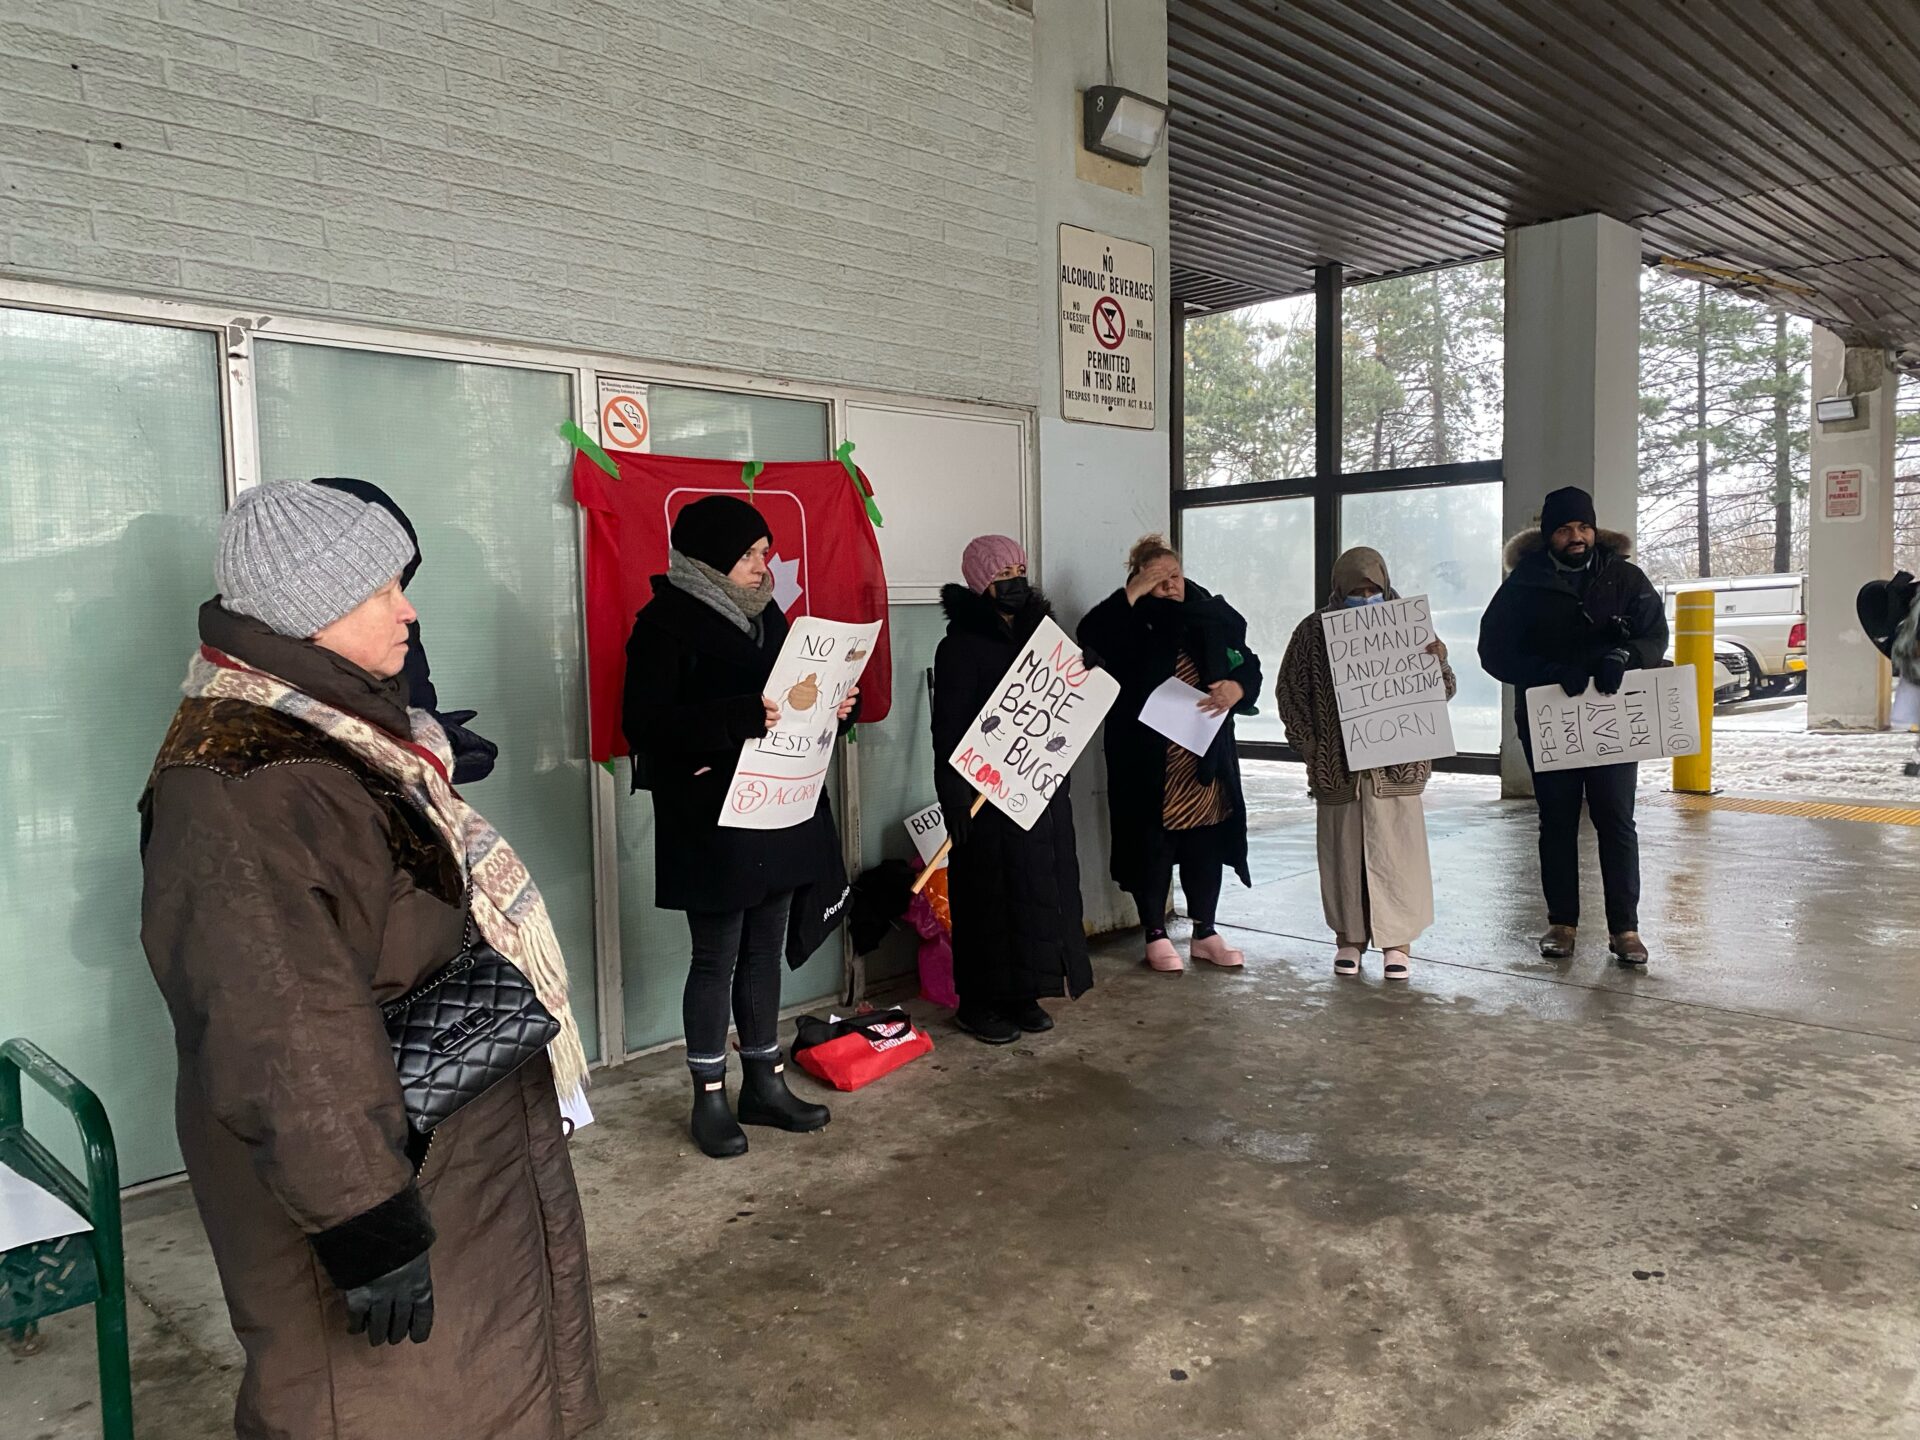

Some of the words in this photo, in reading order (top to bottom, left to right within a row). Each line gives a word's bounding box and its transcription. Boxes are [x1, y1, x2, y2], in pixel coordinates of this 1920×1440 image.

[1102, 253, 1114, 273] NO
[1061, 264, 1105, 292] ALCOHOLIC
[1109, 276, 1153, 302] BEVERAGES
[1062, 310, 1091, 324] EXCESSIVE
[1072, 301, 1080, 311] NO
[1069, 322, 1085, 334] NOISE
[1127, 327, 1152, 341] LOITERING
[1136, 319, 1144, 329] NO
[1087, 350, 1131, 374] PERMITTED
[1065, 389, 1091, 402] TRESPASS
[1092, 393, 1099, 404] TO
[1101, 395, 1126, 407] PROPERTY
[1127, 399, 1137, 409] ACT
[1082, 369, 1091, 388] IN
[1094, 371, 1112, 391] THIS
[1116, 375, 1136, 394] AREA
[1829, 492, 1858, 500] PARKING
[1323, 599, 1427, 636] TENANTS
[800, 634, 835, 657] NO
[1329, 626, 1428, 662] DEMAND
[1048, 639, 1090, 687] NO
[1332, 652, 1435, 687] LANDLORD
[1016, 649, 1084, 724] MORE
[1337, 669, 1442, 714] LICENSING
[998, 683, 1051, 737] BED
[1667, 687, 1684, 730] ACORN
[757, 729, 812, 752] PESTS
[1350, 712, 1436, 752] ACORN
[1536, 704, 1559, 764] PESTS
[1561, 707, 1582, 755] DON'T
[1585, 702, 1624, 757] PAY
[955, 747, 1011, 800] ACORN
[1003, 736, 1065, 801] BUGS
[768, 780, 821, 805] ACORN
